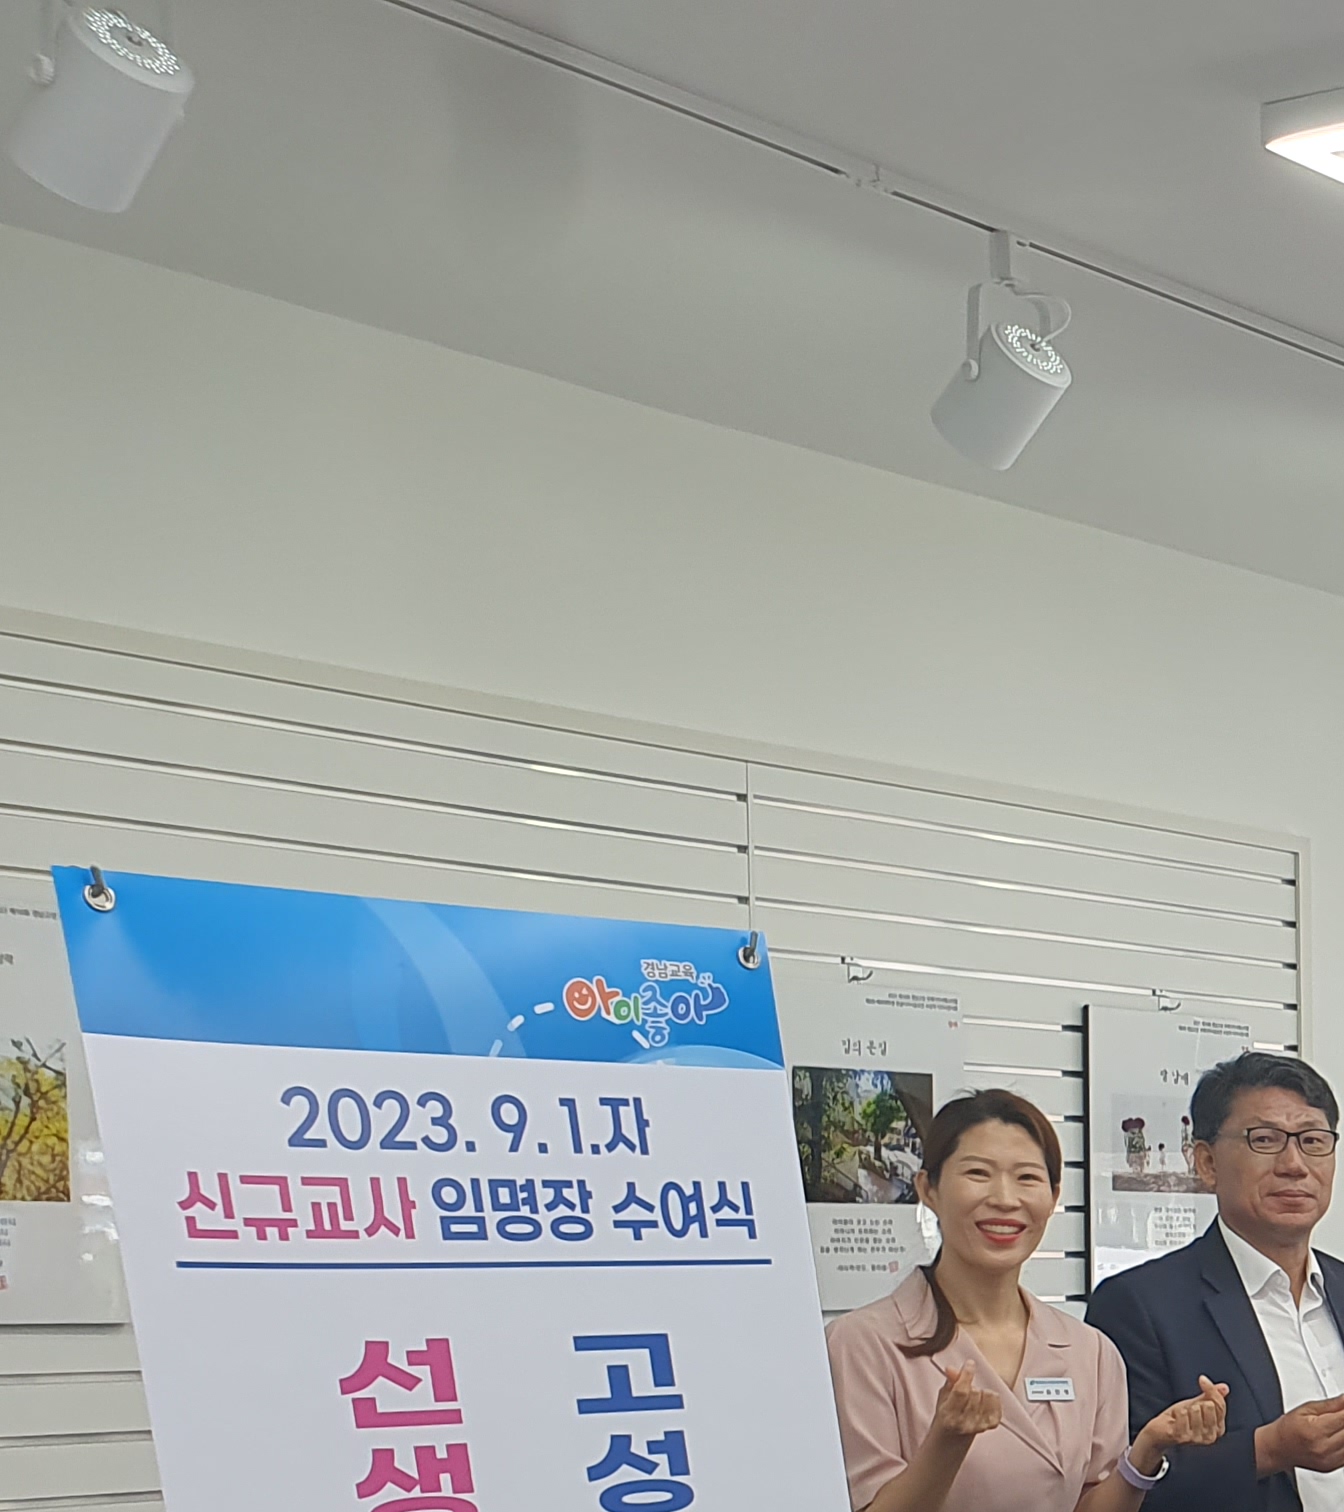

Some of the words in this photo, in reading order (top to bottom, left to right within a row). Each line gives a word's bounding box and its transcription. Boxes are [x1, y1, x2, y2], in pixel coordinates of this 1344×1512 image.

[641, 960, 697, 983] 경남교육
[563, 974, 729, 1047] 아이좋아
[176, 1171, 417, 1242] 신규교사
[432, 1176, 593, 1244] 임명장
[610, 1179, 759, 1242] 수여식
